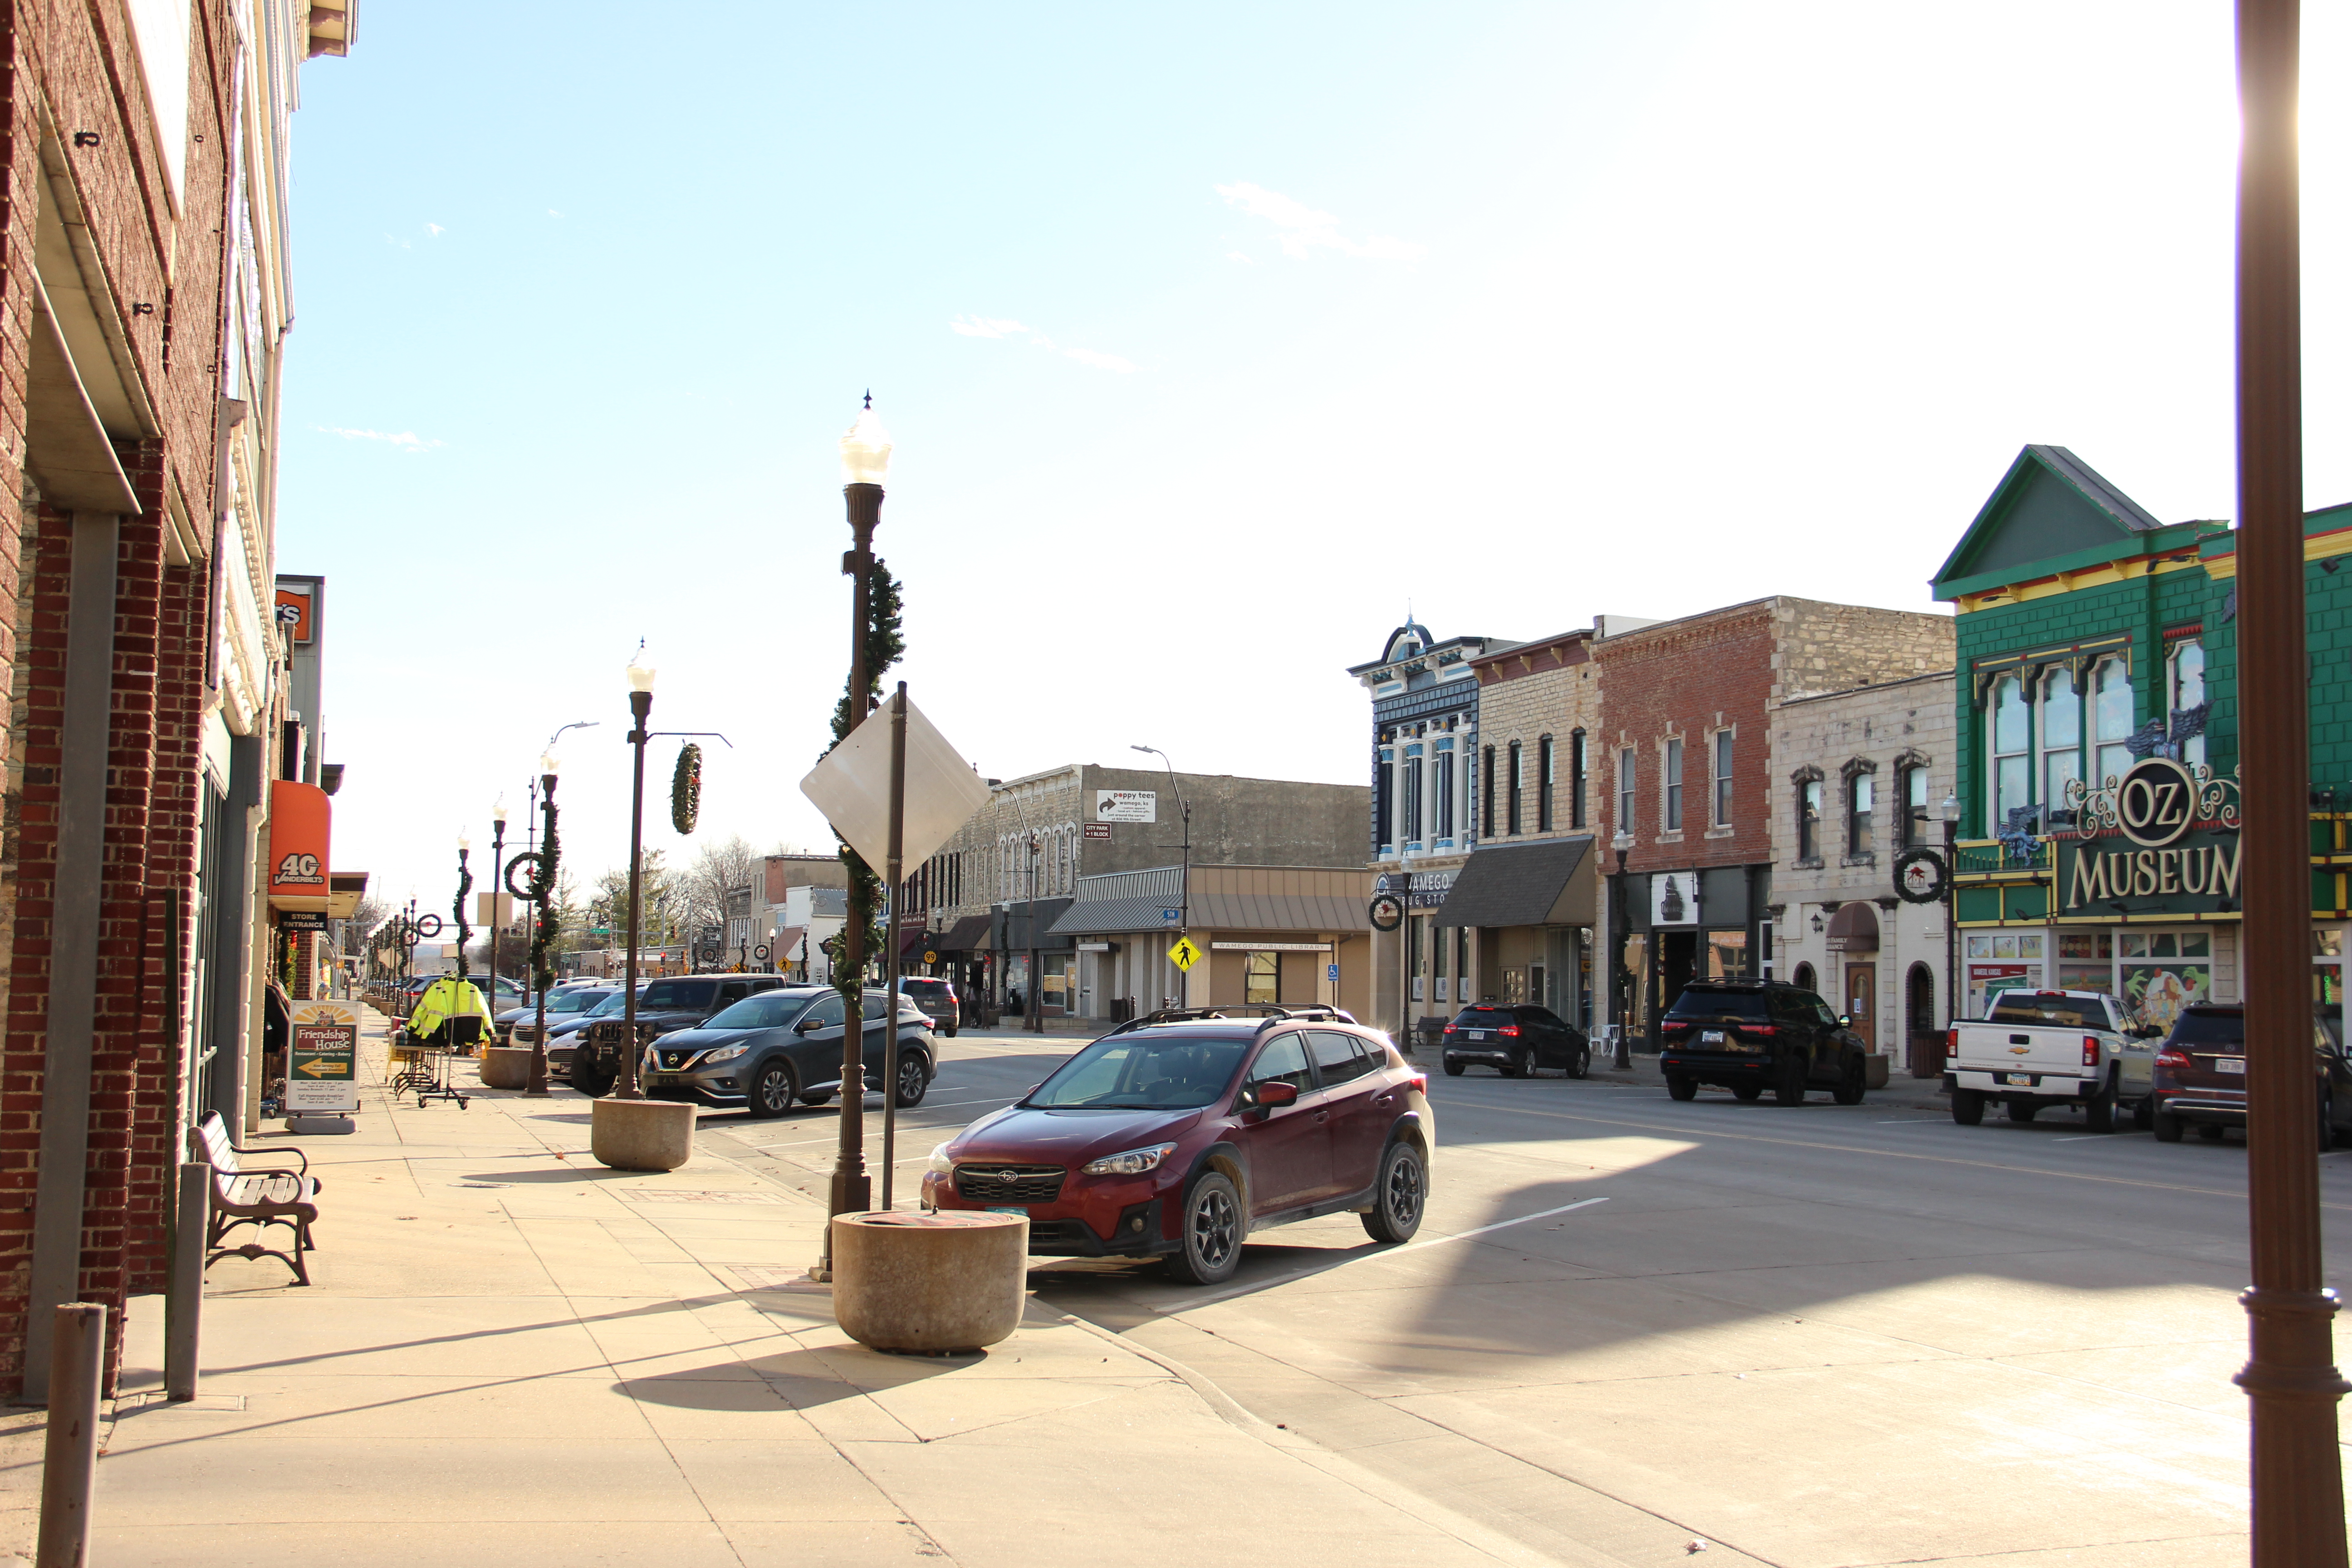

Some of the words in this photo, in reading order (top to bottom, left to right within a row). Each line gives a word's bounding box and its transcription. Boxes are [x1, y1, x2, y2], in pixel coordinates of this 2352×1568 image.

[2122, 778, 2184, 828] OZ
[281, 854, 318, 877] 40
[2066, 833, 2242, 908] MUSEUM
[274, 871, 323, 884] VANDERBILT'S
[1396, 896, 1420, 906] RUG
[1427, 893, 1445, 904] STO
[299, 1029, 350, 1041] Friendship
[315, 1039, 350, 1050] House
